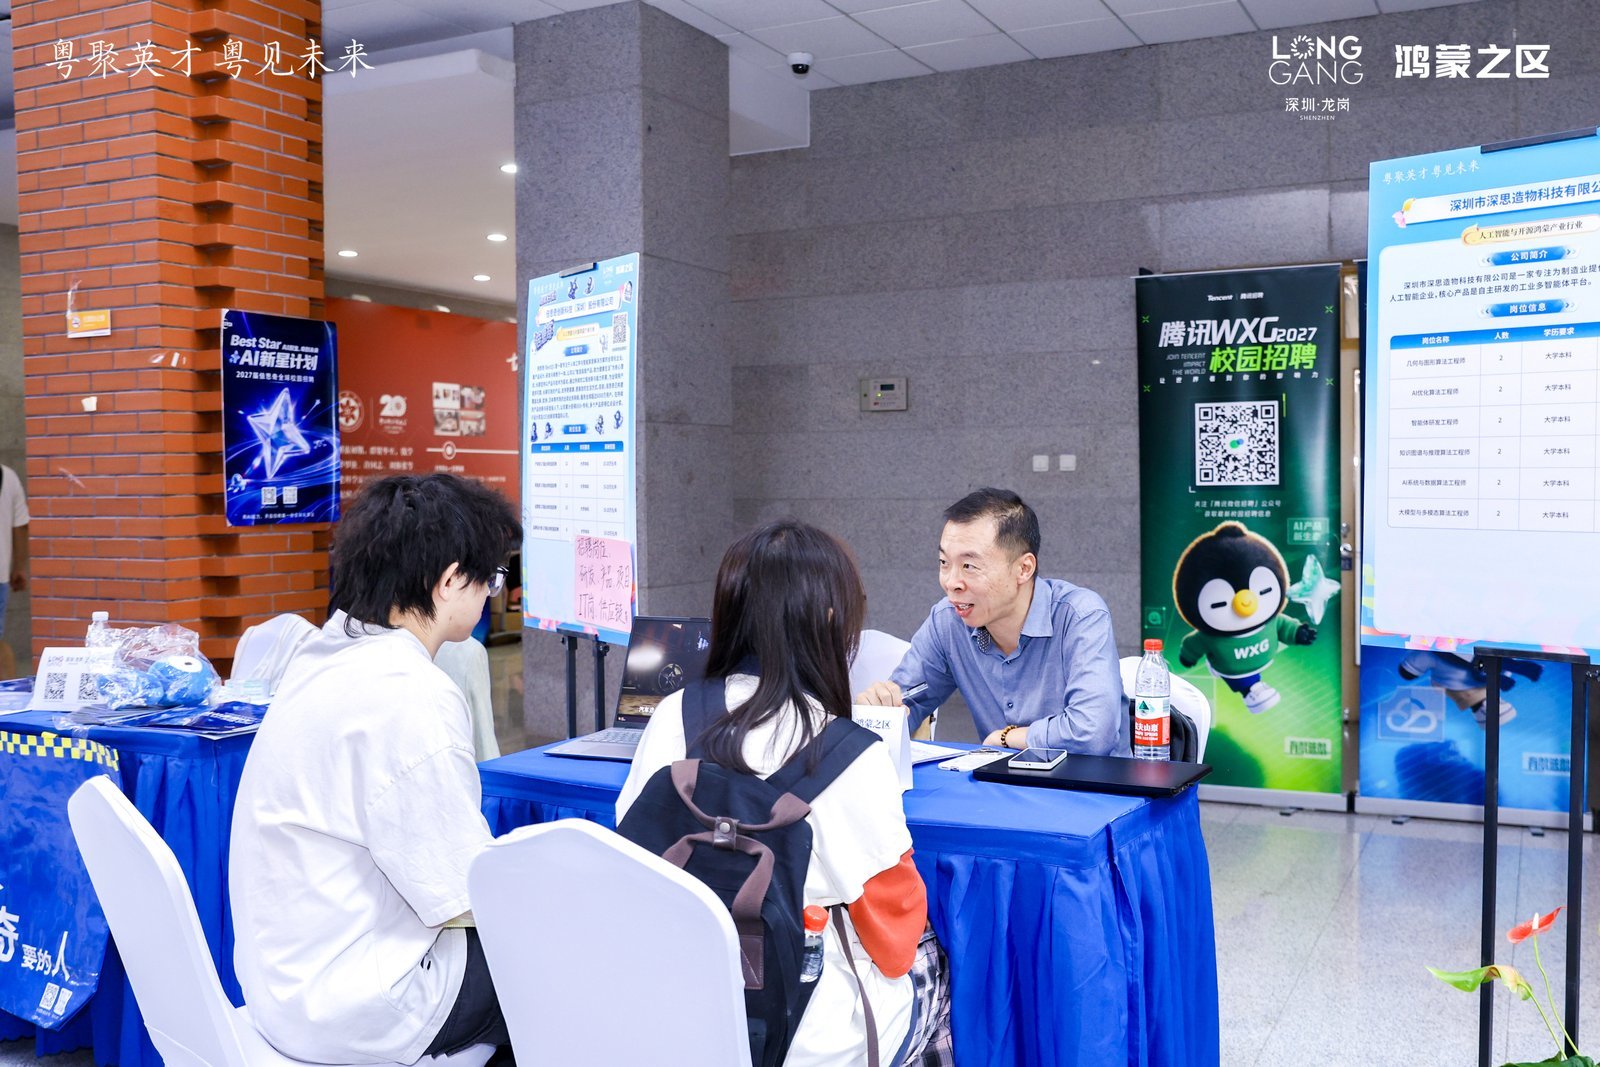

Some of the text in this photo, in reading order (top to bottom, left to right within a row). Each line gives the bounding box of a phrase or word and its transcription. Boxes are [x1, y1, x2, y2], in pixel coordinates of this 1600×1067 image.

[1382, 159, 1480, 184] 粤聚英才 粤见未来
[1479, 220, 1584, 240] 人工智能与开源鸿蒙产业行业
[1510, 249, 1548, 262] 公司简介
[1403, 264, 1600, 289] 深圳市深思造物科技有限公司是一家专注为制造业提
[1208, 294, 1233, 302] Tencent
[1509, 302, 1547, 314] 岗位信息
[230, 334, 257, 347] Best
[258, 337, 282, 350] Star
[1421, 327, 1575, 345] 岗位名称 人数 学历要求
[239, 350, 319, 371] AI新星计划
[1181, 352, 1206, 360] TENCENT
[1209, 343, 1317, 373] 校园招聘
[1545, 351, 1572, 360] 大学本科
[1411, 387, 1459, 397] AI优化算法工程师
[1544, 383, 1571, 392] 大学本科
[1411, 418, 1459, 427] 智能体研发工程师
[1544, 415, 1571, 424] 大学本科
[1543, 447, 1570, 456] 大学本科
[1543, 479, 1570, 488] 大学本科
[1542, 511, 1569, 519] 大学本科
[1233, 639, 1270, 660] WXG
